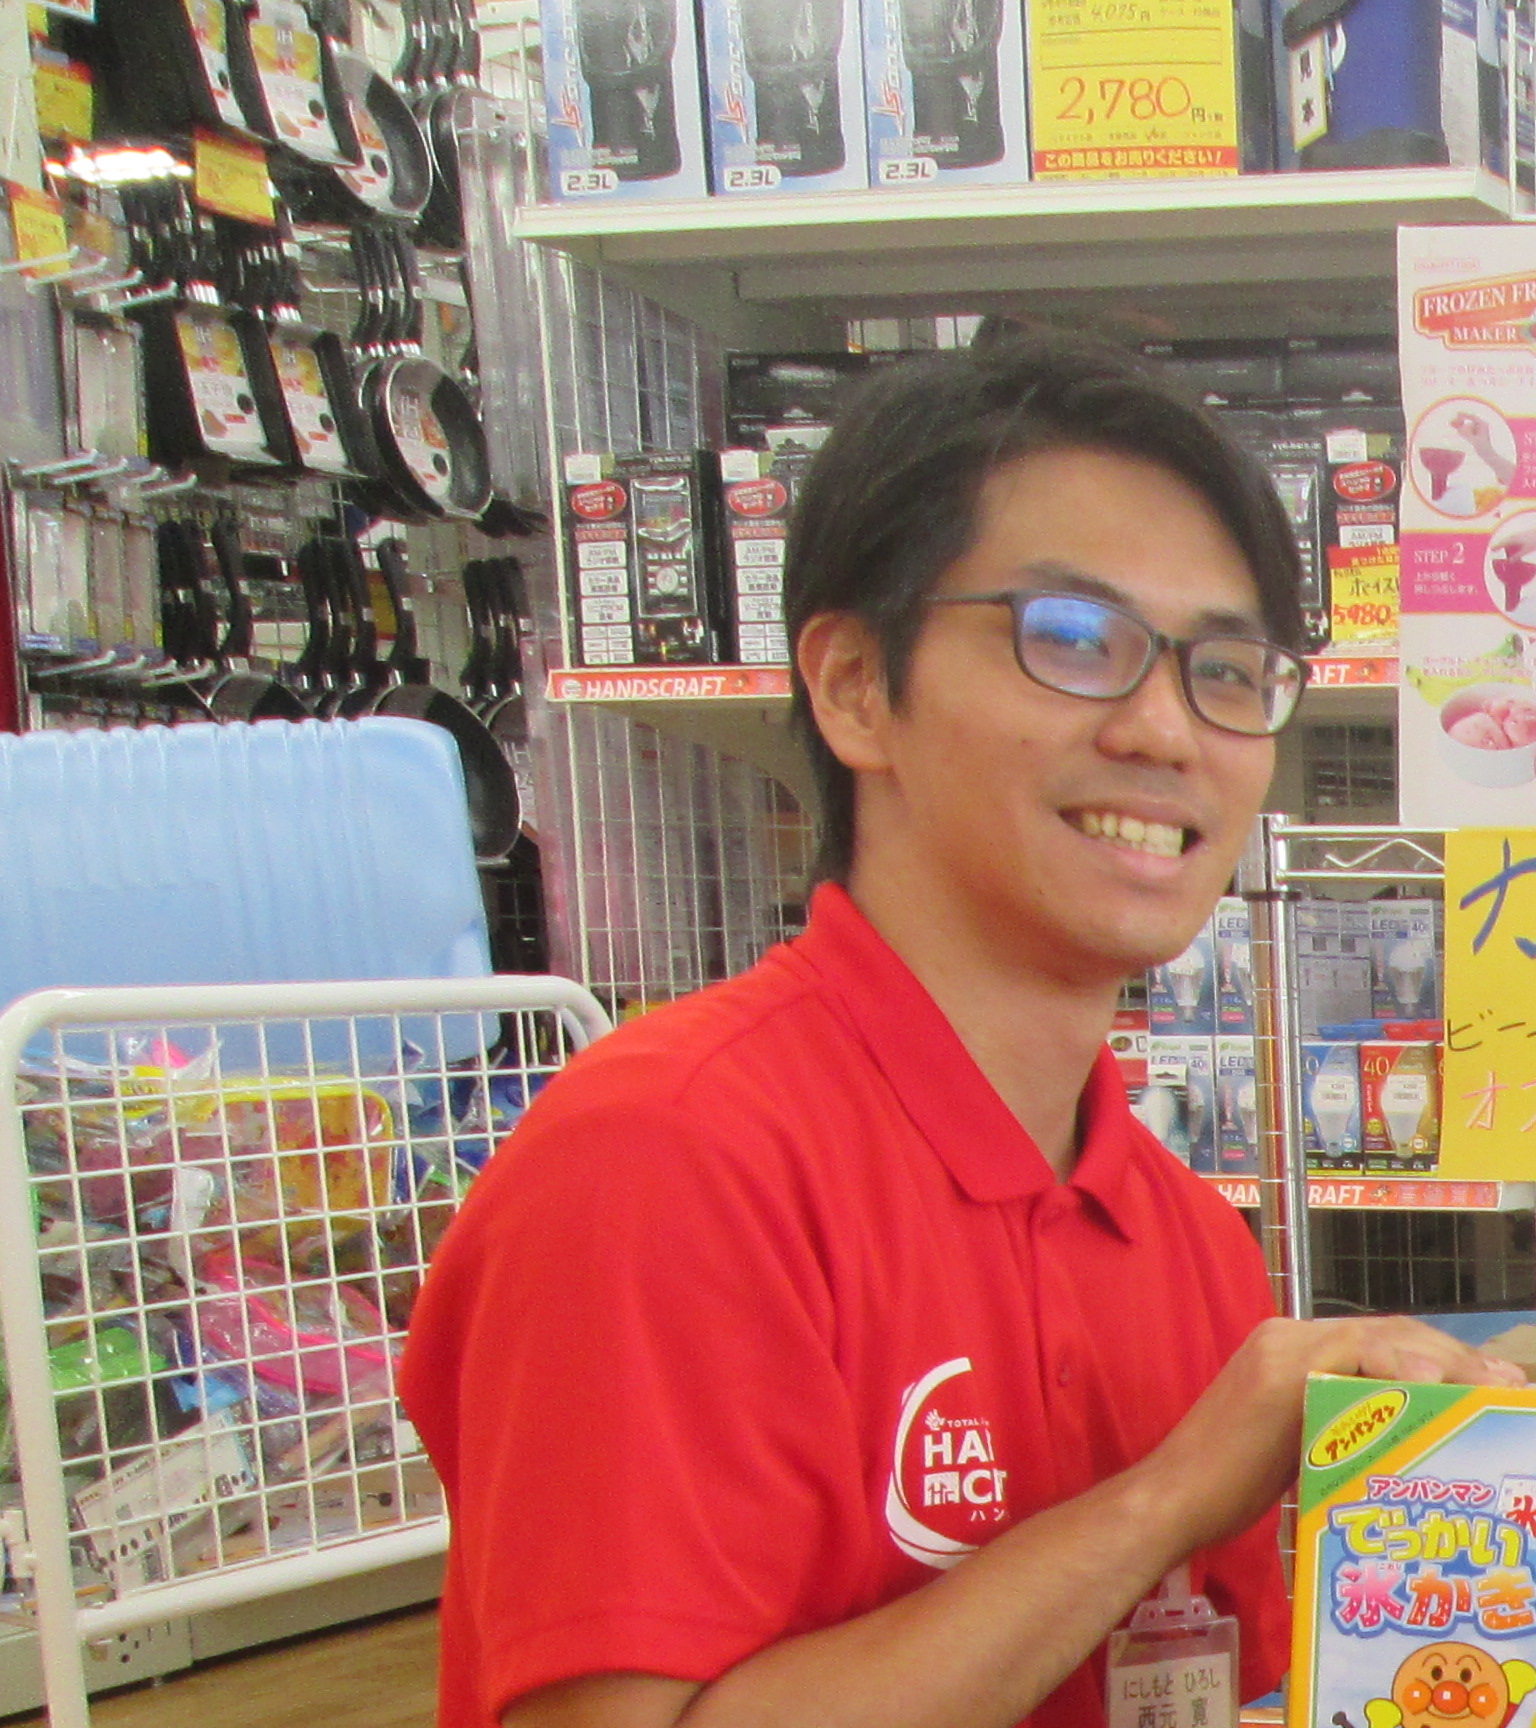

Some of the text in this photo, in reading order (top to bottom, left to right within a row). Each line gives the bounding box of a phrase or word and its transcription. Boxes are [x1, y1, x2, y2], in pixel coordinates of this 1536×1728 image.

[1055, 76, 1192, 126] 2,780
[567, 174, 611, 192] 2.3L
[729, 170, 775, 188] 2.3L
[885, 162, 931, 181] 2.3L
[1422, 284, 1506, 318] FROZEN
[1453, 325, 1519, 341] MAKER
[1414, 542, 1465, 566] STEP 2
[586, 675, 728, 700] HANDSCRAFT
[1363, 1055, 1390, 1077] 40
[1369, 1478, 1493, 1502] アンパンマン
[1335, 1507, 1522, 1568] でっかい
[1339, 1567, 1536, 1630] 氷かき
